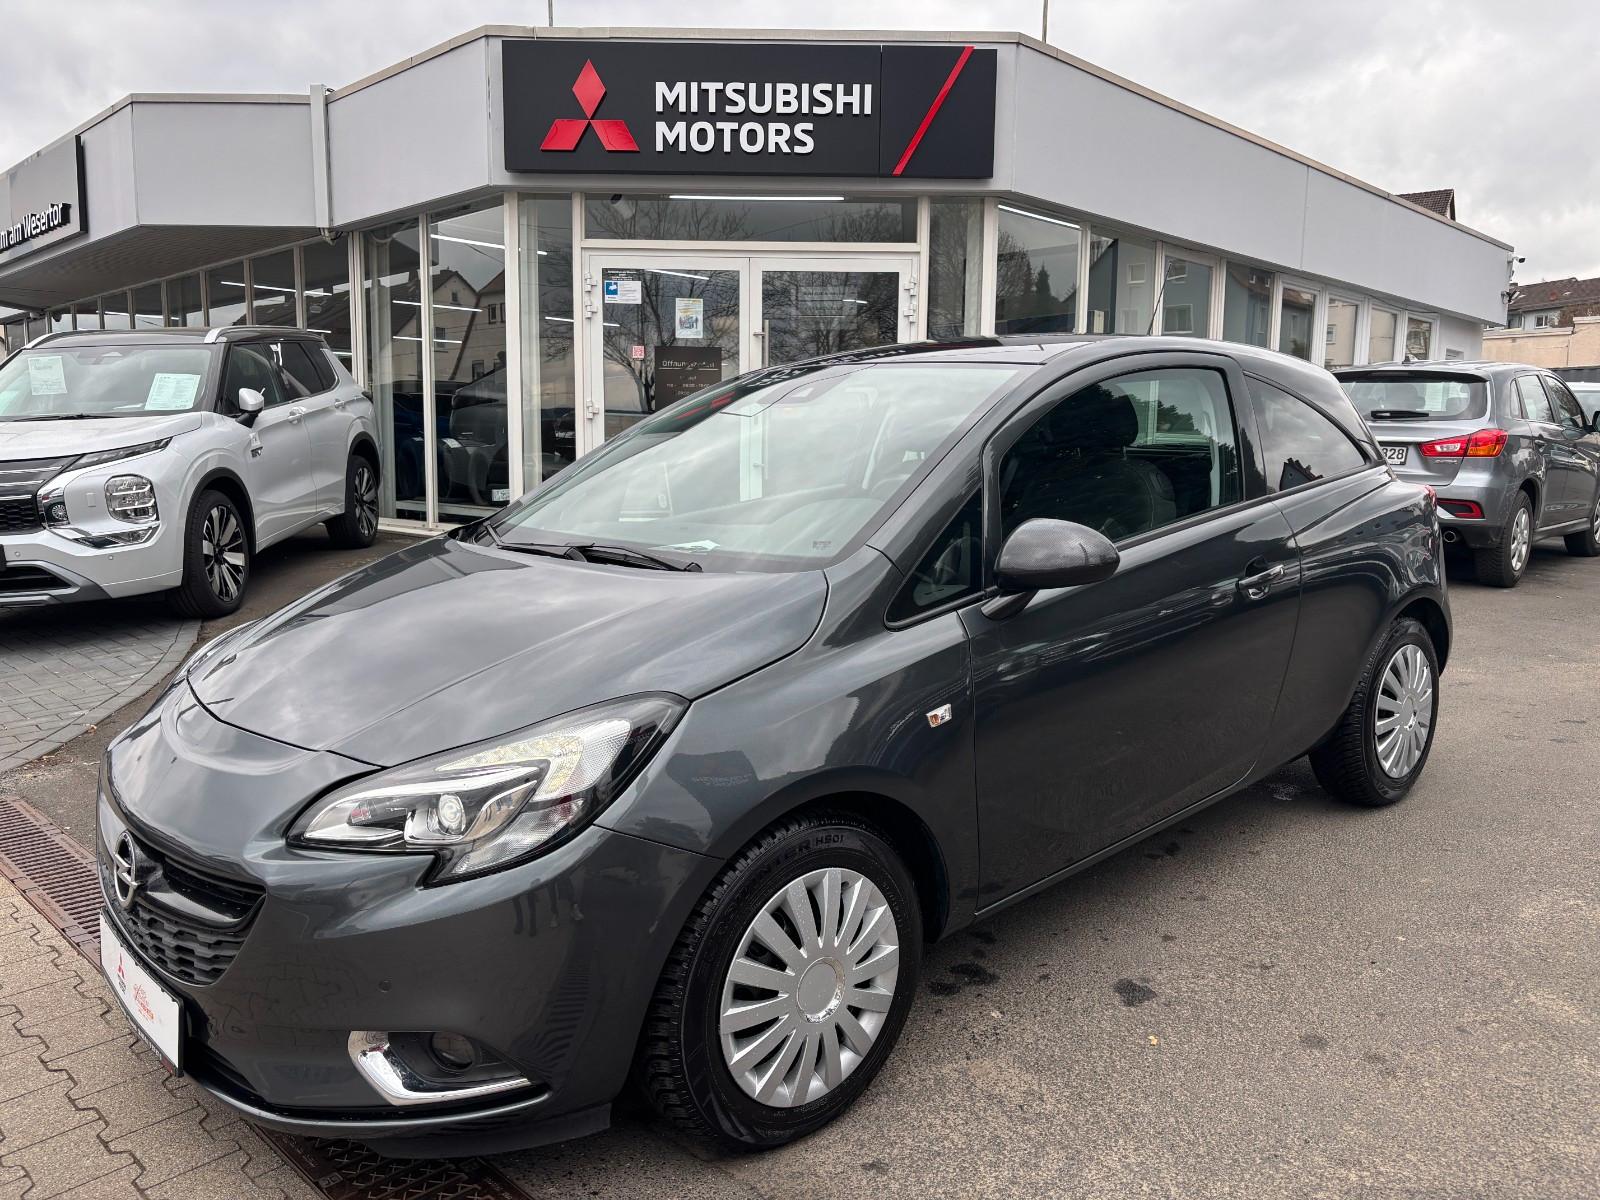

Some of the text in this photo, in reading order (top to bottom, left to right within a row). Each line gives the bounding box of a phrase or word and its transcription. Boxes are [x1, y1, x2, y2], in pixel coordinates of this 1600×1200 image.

[655, 81, 872, 115] MITSUBISHI
[655, 121, 816, 154] MOTORS
[9, 222, 22, 245] am
[23, 202, 64, 239] Wesertor
